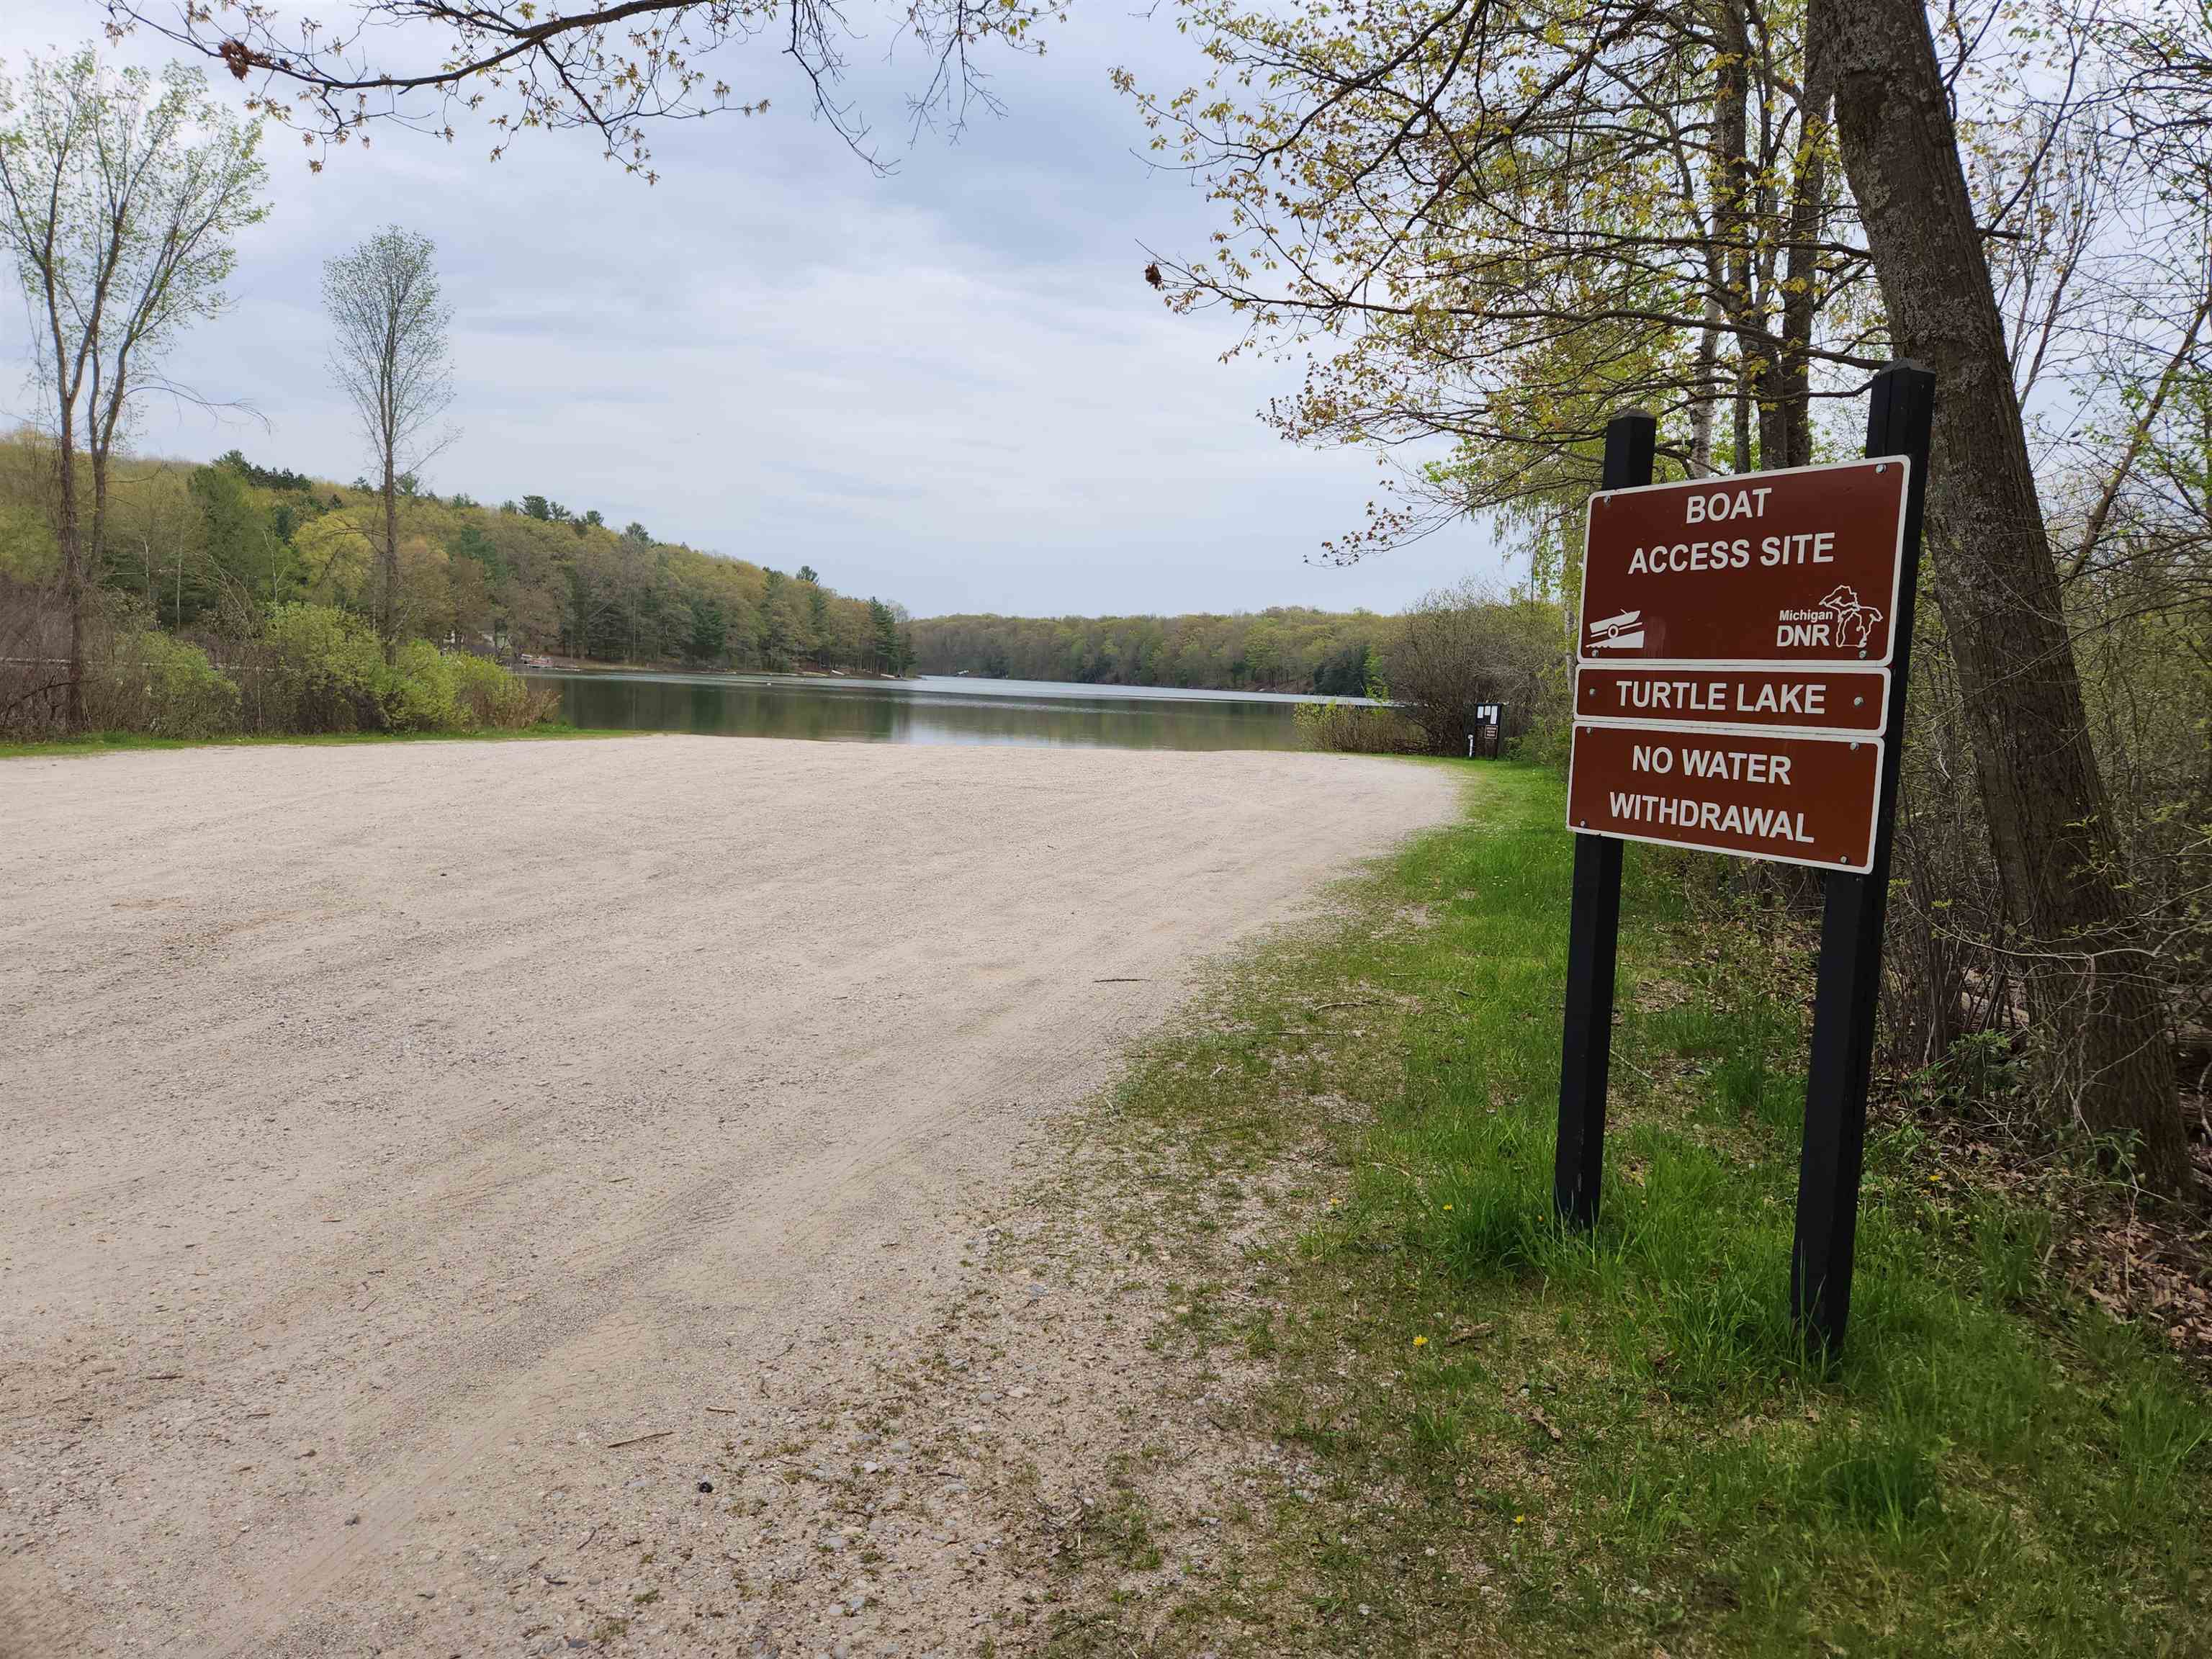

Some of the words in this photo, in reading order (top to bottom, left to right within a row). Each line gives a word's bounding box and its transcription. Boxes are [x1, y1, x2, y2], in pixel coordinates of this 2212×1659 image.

[1686, 487, 1772, 524] BOAT
[1627, 539, 1750, 575] ACCESS
[1760, 532, 1835, 565] SITE
[1779, 609, 1833, 622] Michigan
[1776, 624, 1830, 648] DNR
[1616, 680, 1727, 711] TURTLE
[1736, 683, 1827, 714] LAKE
[1632, 745, 1673, 773] NO
[1681, 748, 1791, 785] WATER
[1609, 791, 1815, 843] WITHDRAWAL
